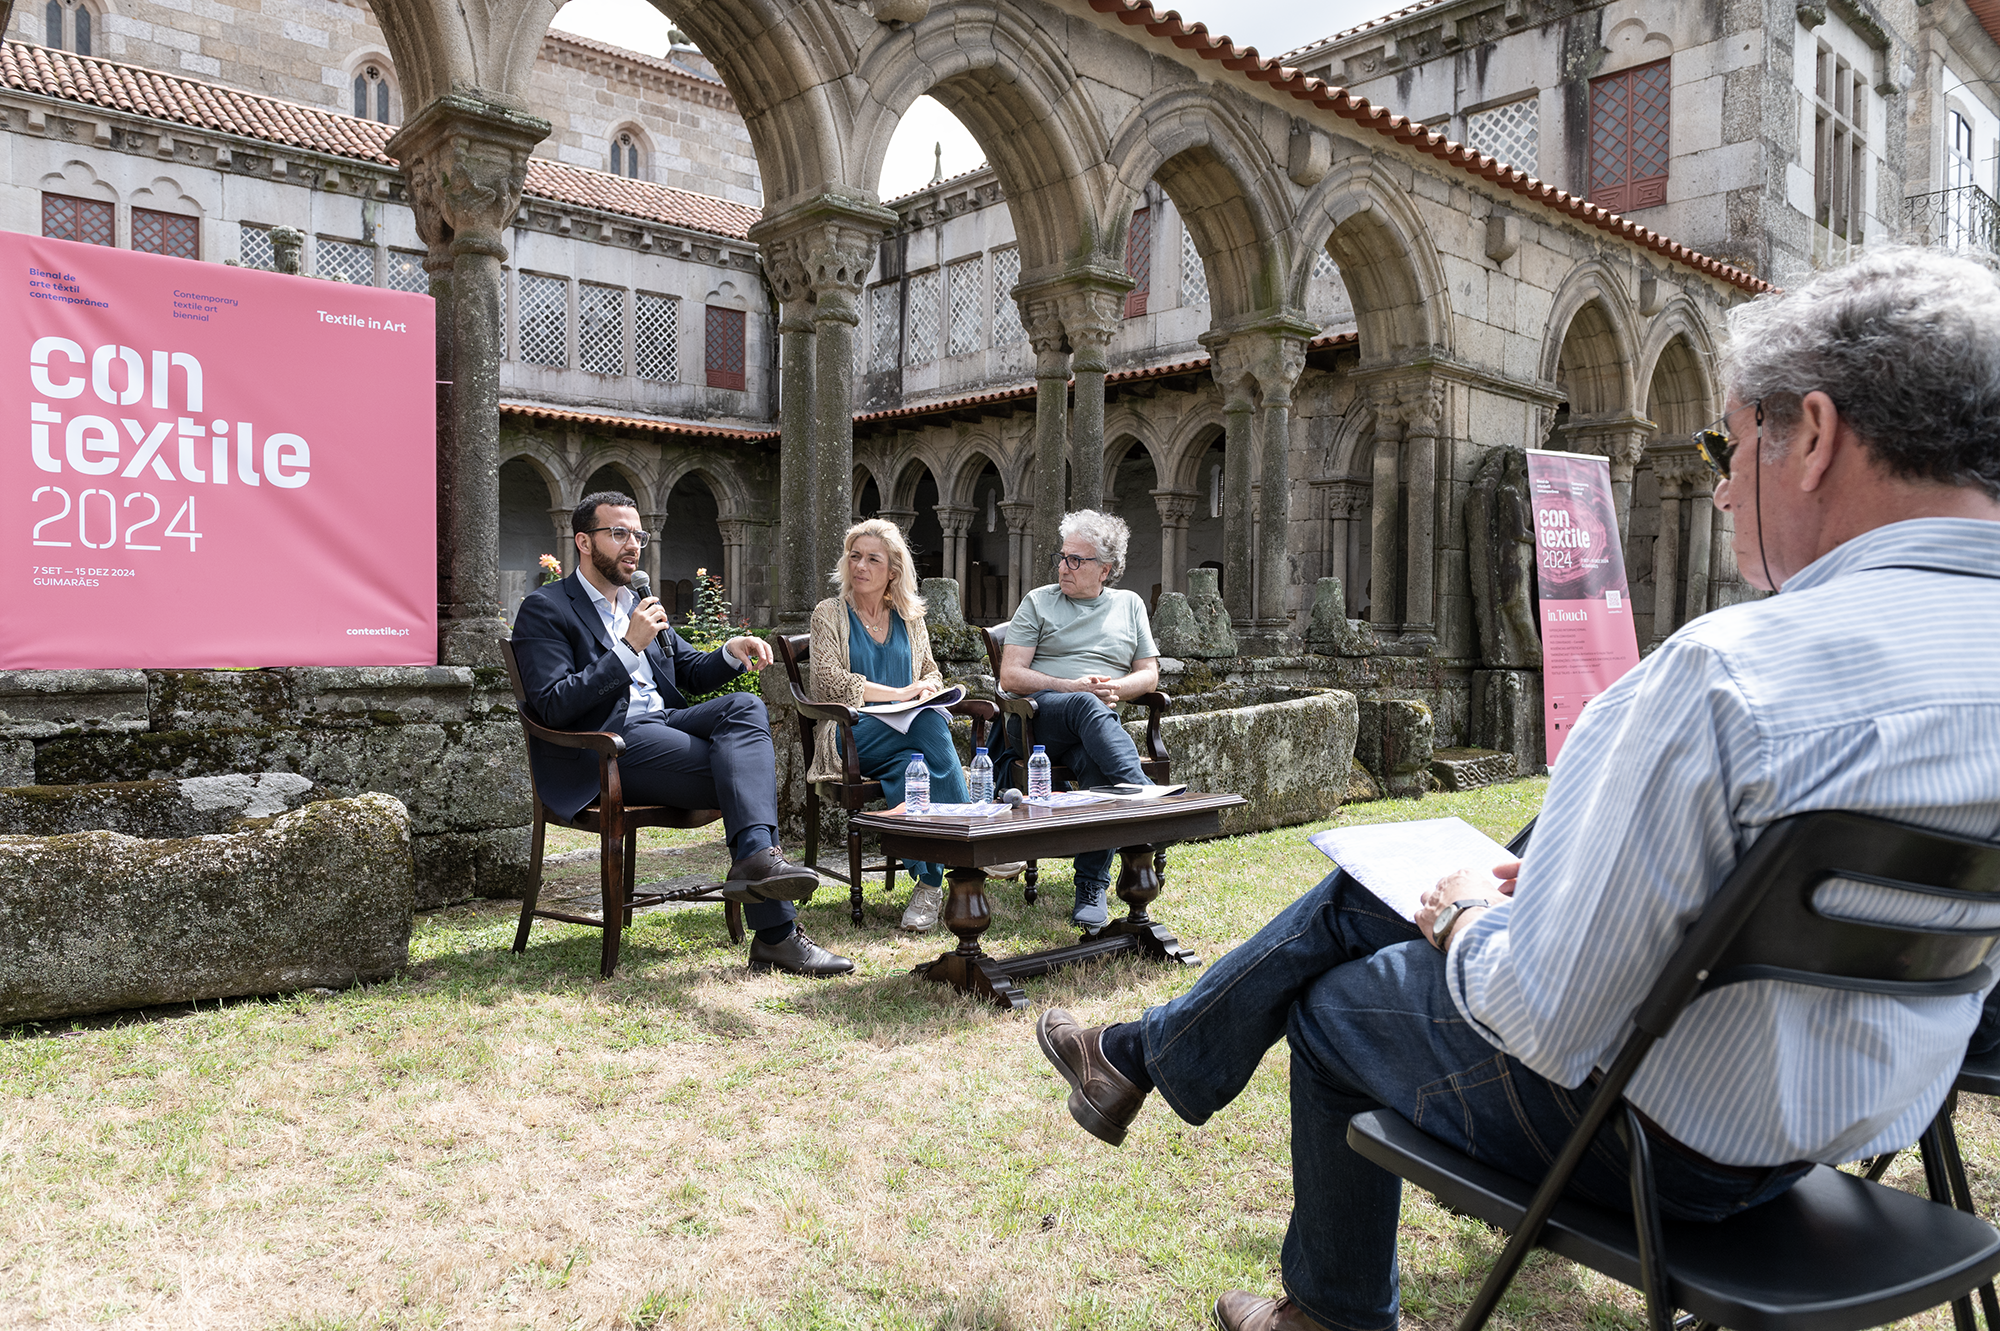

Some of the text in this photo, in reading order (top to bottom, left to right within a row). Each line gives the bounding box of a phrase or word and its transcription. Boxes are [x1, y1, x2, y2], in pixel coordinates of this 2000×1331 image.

[29, 267, 76, 282] Bienal de
[29, 279, 80, 293] arte têxtil
[29, 291, 109, 308] contemporânea
[173, 289, 239, 307] Contemporary
[173, 300, 218, 313] textile art
[173, 310, 209, 322] biennial
[316, 310, 407, 333] Textile in Art
[30, 336, 203, 413] con
[30, 401, 311, 489] textile
[31, 485, 203, 552] 2024
[1540, 509, 1569, 527] con
[1541, 528, 1590, 548] textile
[1543, 550, 1572, 568] 2024
[33, 566, 39, 574] 7
[41, 566, 63, 575] SET
[75, 567, 86, 576] 15
[88, 567, 109, 576] DEZ
[111, 568, 135, 577] 2024
[33, 577, 100, 587] GUIMARÃES
[1548, 609, 1587, 621] in.Touch
[346, 626, 410, 637] contextile.pt
